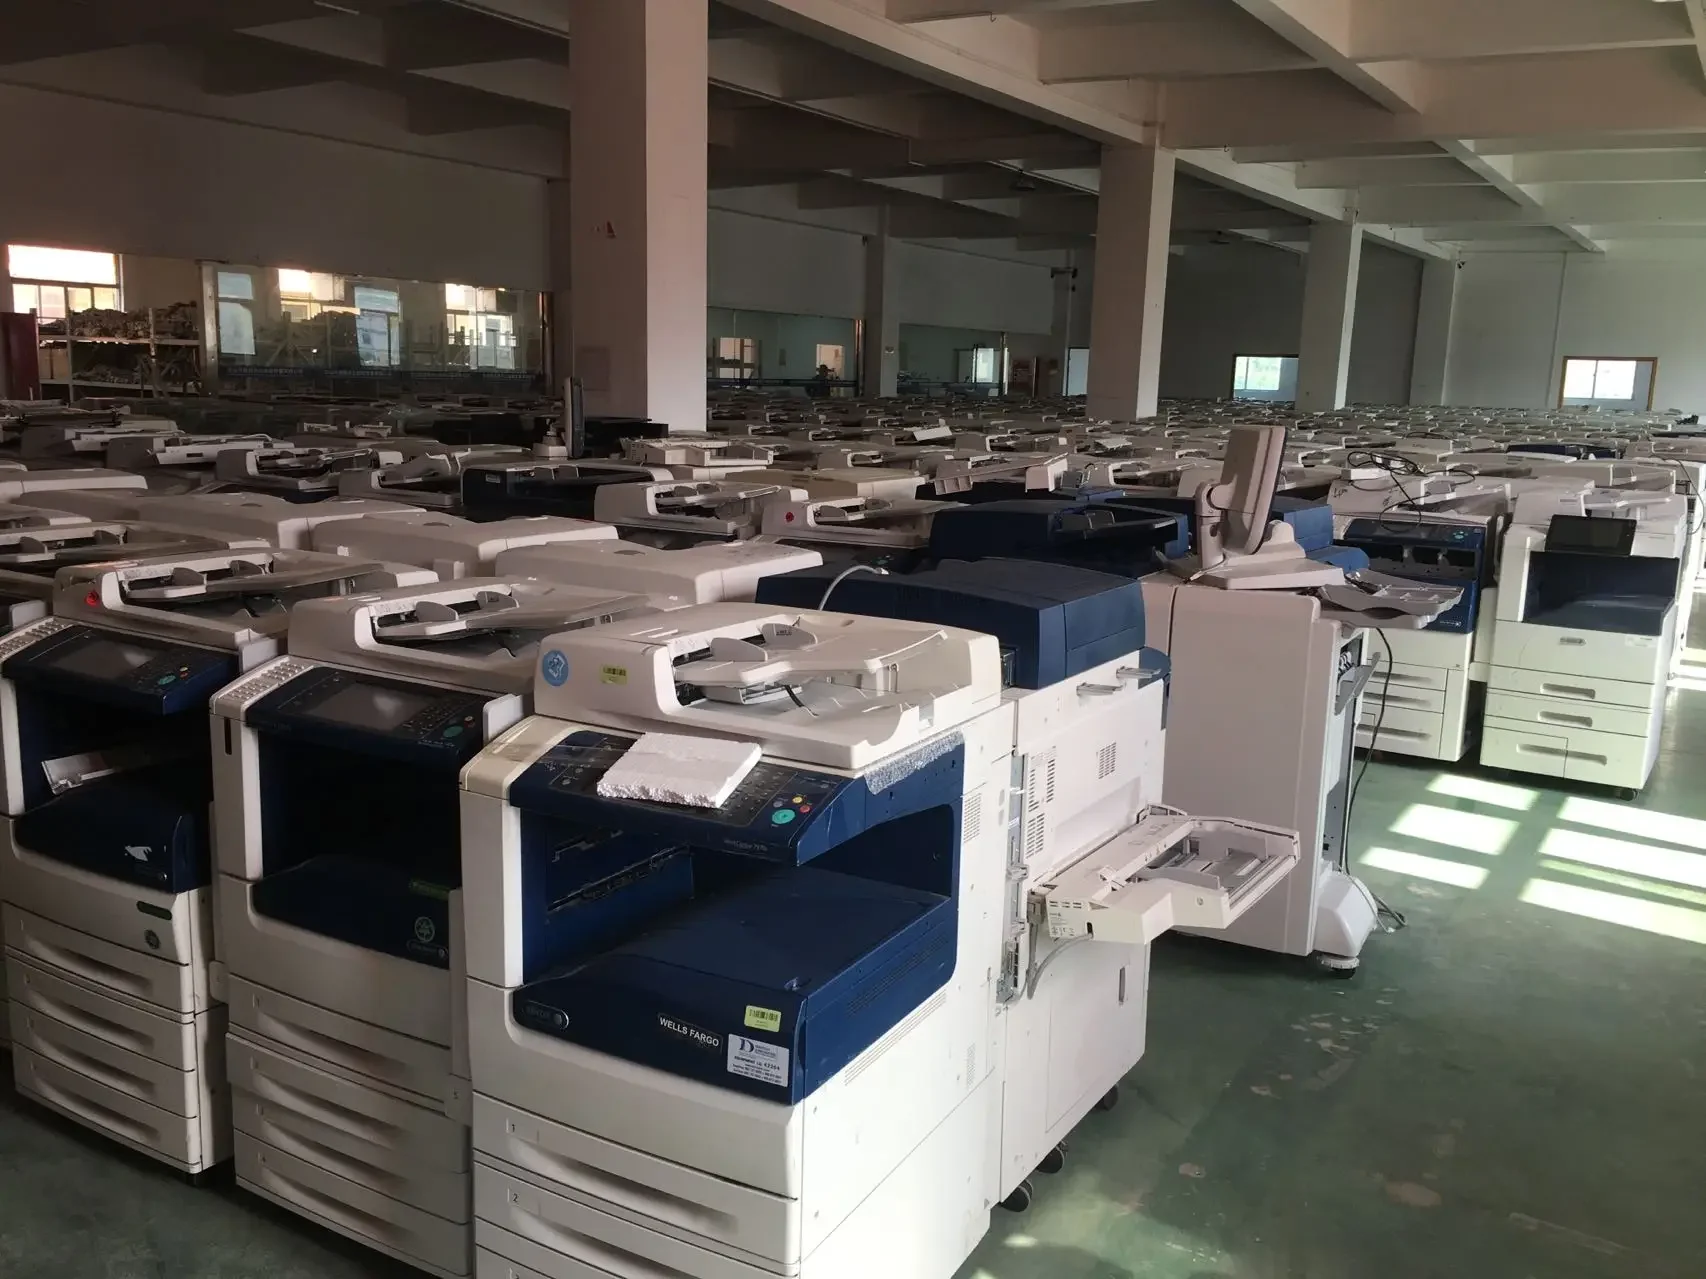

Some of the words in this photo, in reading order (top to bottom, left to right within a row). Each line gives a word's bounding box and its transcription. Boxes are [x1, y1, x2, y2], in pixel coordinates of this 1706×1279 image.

[660, 1017, 688, 1035] WELLS
[689, 1029, 719, 1047] FARGO
[511, 1124, 515, 1132] 1
[512, 1193, 519, 1202] 2
